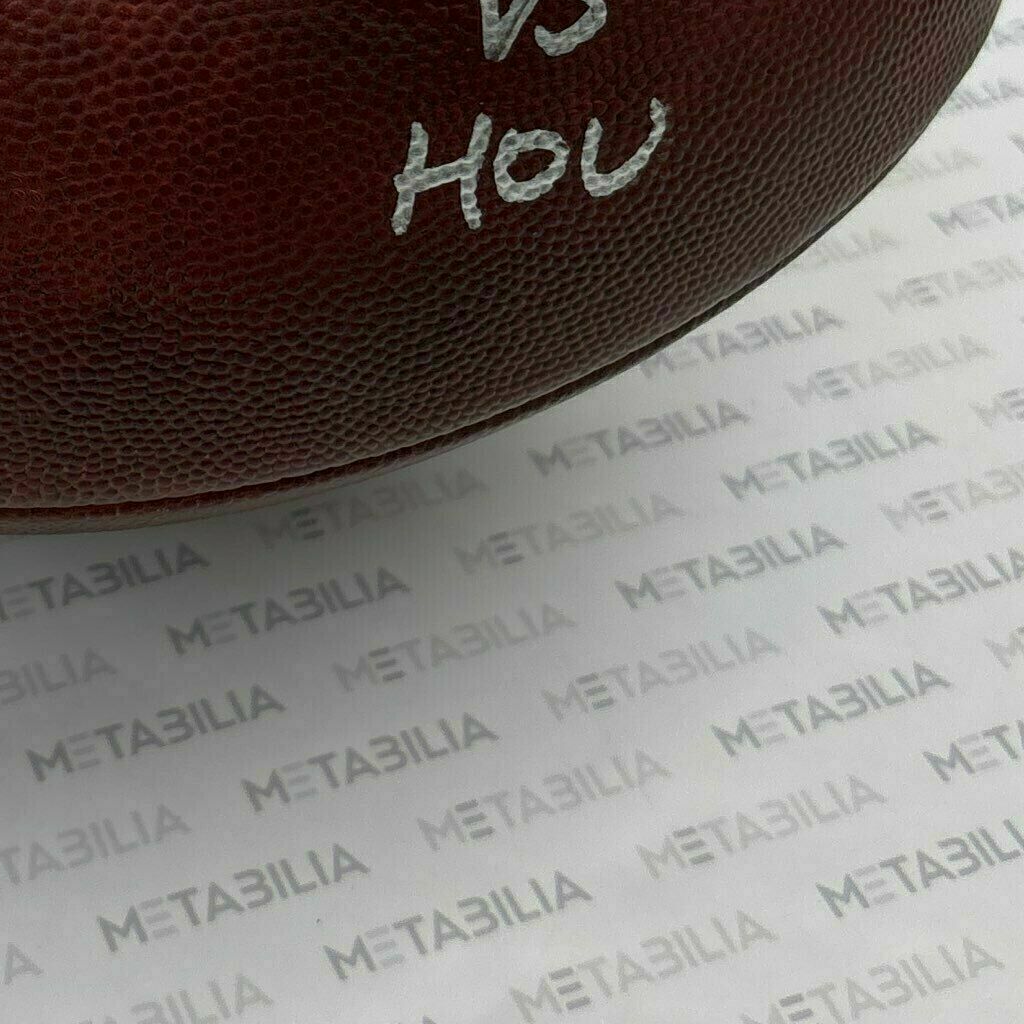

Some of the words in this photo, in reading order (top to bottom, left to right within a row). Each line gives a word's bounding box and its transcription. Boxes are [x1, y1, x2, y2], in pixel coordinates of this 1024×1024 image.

[392, 97, 667, 235] HOU
[642, 306, 847, 378] METABILIA
[527, 400, 751, 477] METABILIA
[720, 421, 939, 501] METABILIA
[166, 567, 412, 655] METABILIA
[614, 524, 847, 609] METABILIA
[541, 629, 782, 721] METABILIA
[711, 661, 953, 757] METABILIA
[26, 683, 287, 783] METABILIA
[241, 712, 500, 813] METABILIA
[416, 750, 672, 851] METABILIA
[635, 776, 887, 879] METABILIA
[98, 844, 371, 954] METABILIA
[323, 871, 593, 981] METABILIA
